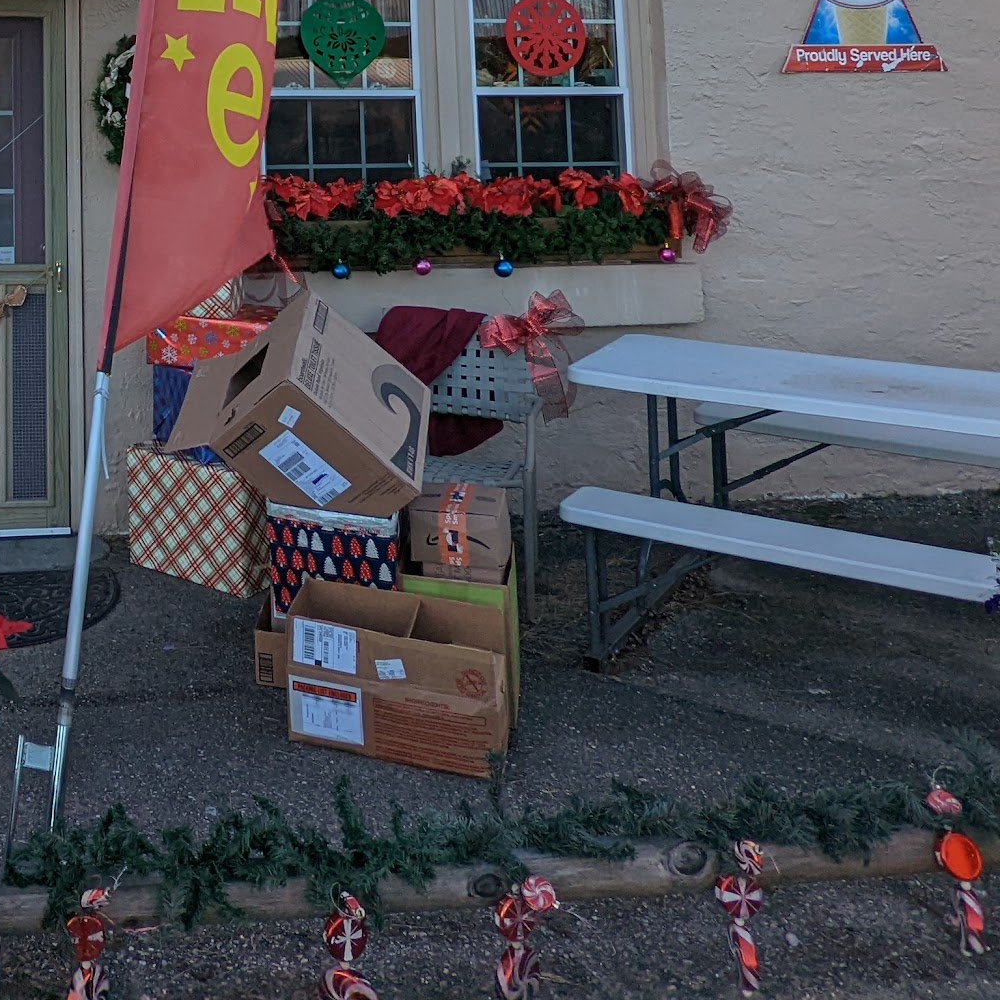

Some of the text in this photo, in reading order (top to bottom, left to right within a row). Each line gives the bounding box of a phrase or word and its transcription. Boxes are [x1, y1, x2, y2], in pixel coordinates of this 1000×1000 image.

[796, 48, 931, 64] Proudly Served Here
